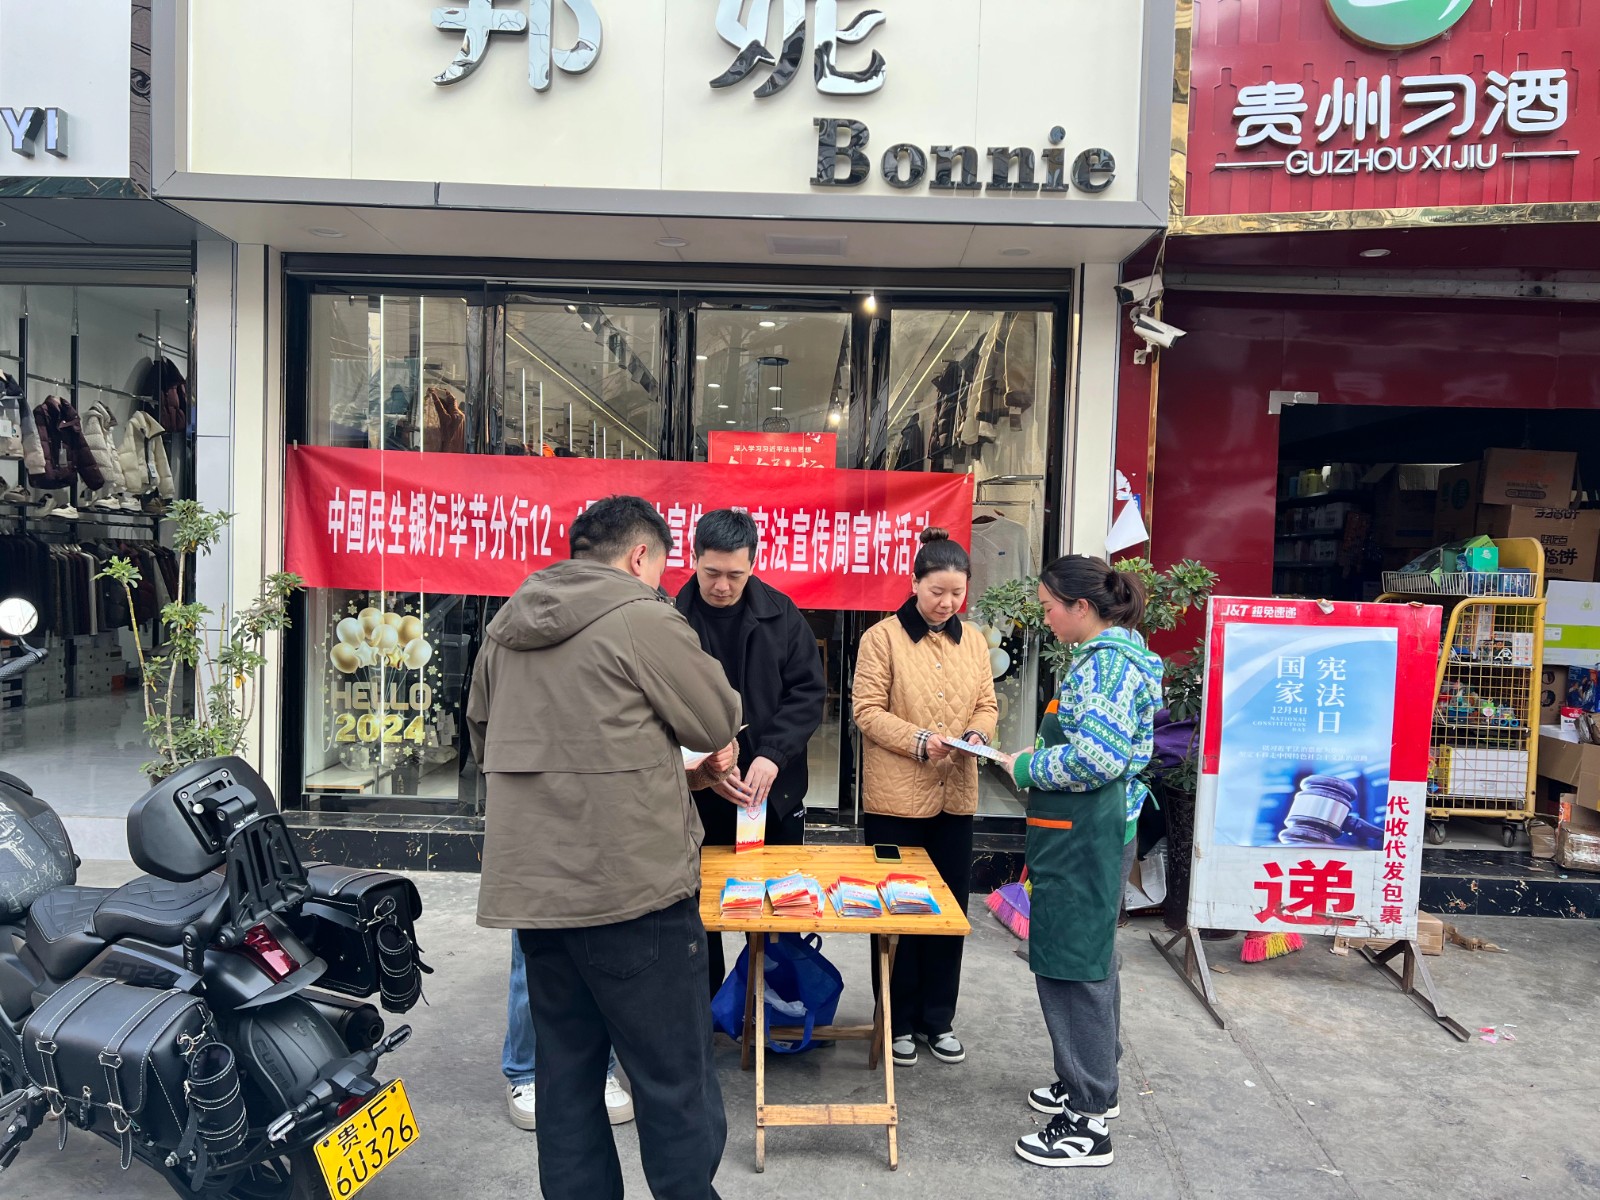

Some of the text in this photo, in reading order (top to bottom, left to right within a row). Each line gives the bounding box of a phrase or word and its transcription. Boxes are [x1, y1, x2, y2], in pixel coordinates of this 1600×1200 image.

[1232, 69, 1568, 147] 贵州习酒
[809, 117, 1117, 193] Bonnie
[1284, 147, 1417, 176] GUIZHOU
[1221, 604, 1251, 617] J&T
[331, 681, 432, 711] HELLO
[1275, 655, 1306, 705] 国家
[1316, 656, 1347, 734] 宪法日
[335, 713, 426, 745] 2024
[1272, 706, 1308, 715] 12月4日
[1380, 796, 1410, 925] 代收代发包裹
[1253, 859, 1358, 927] 递
[336, 1114, 414, 1196] 6U326
